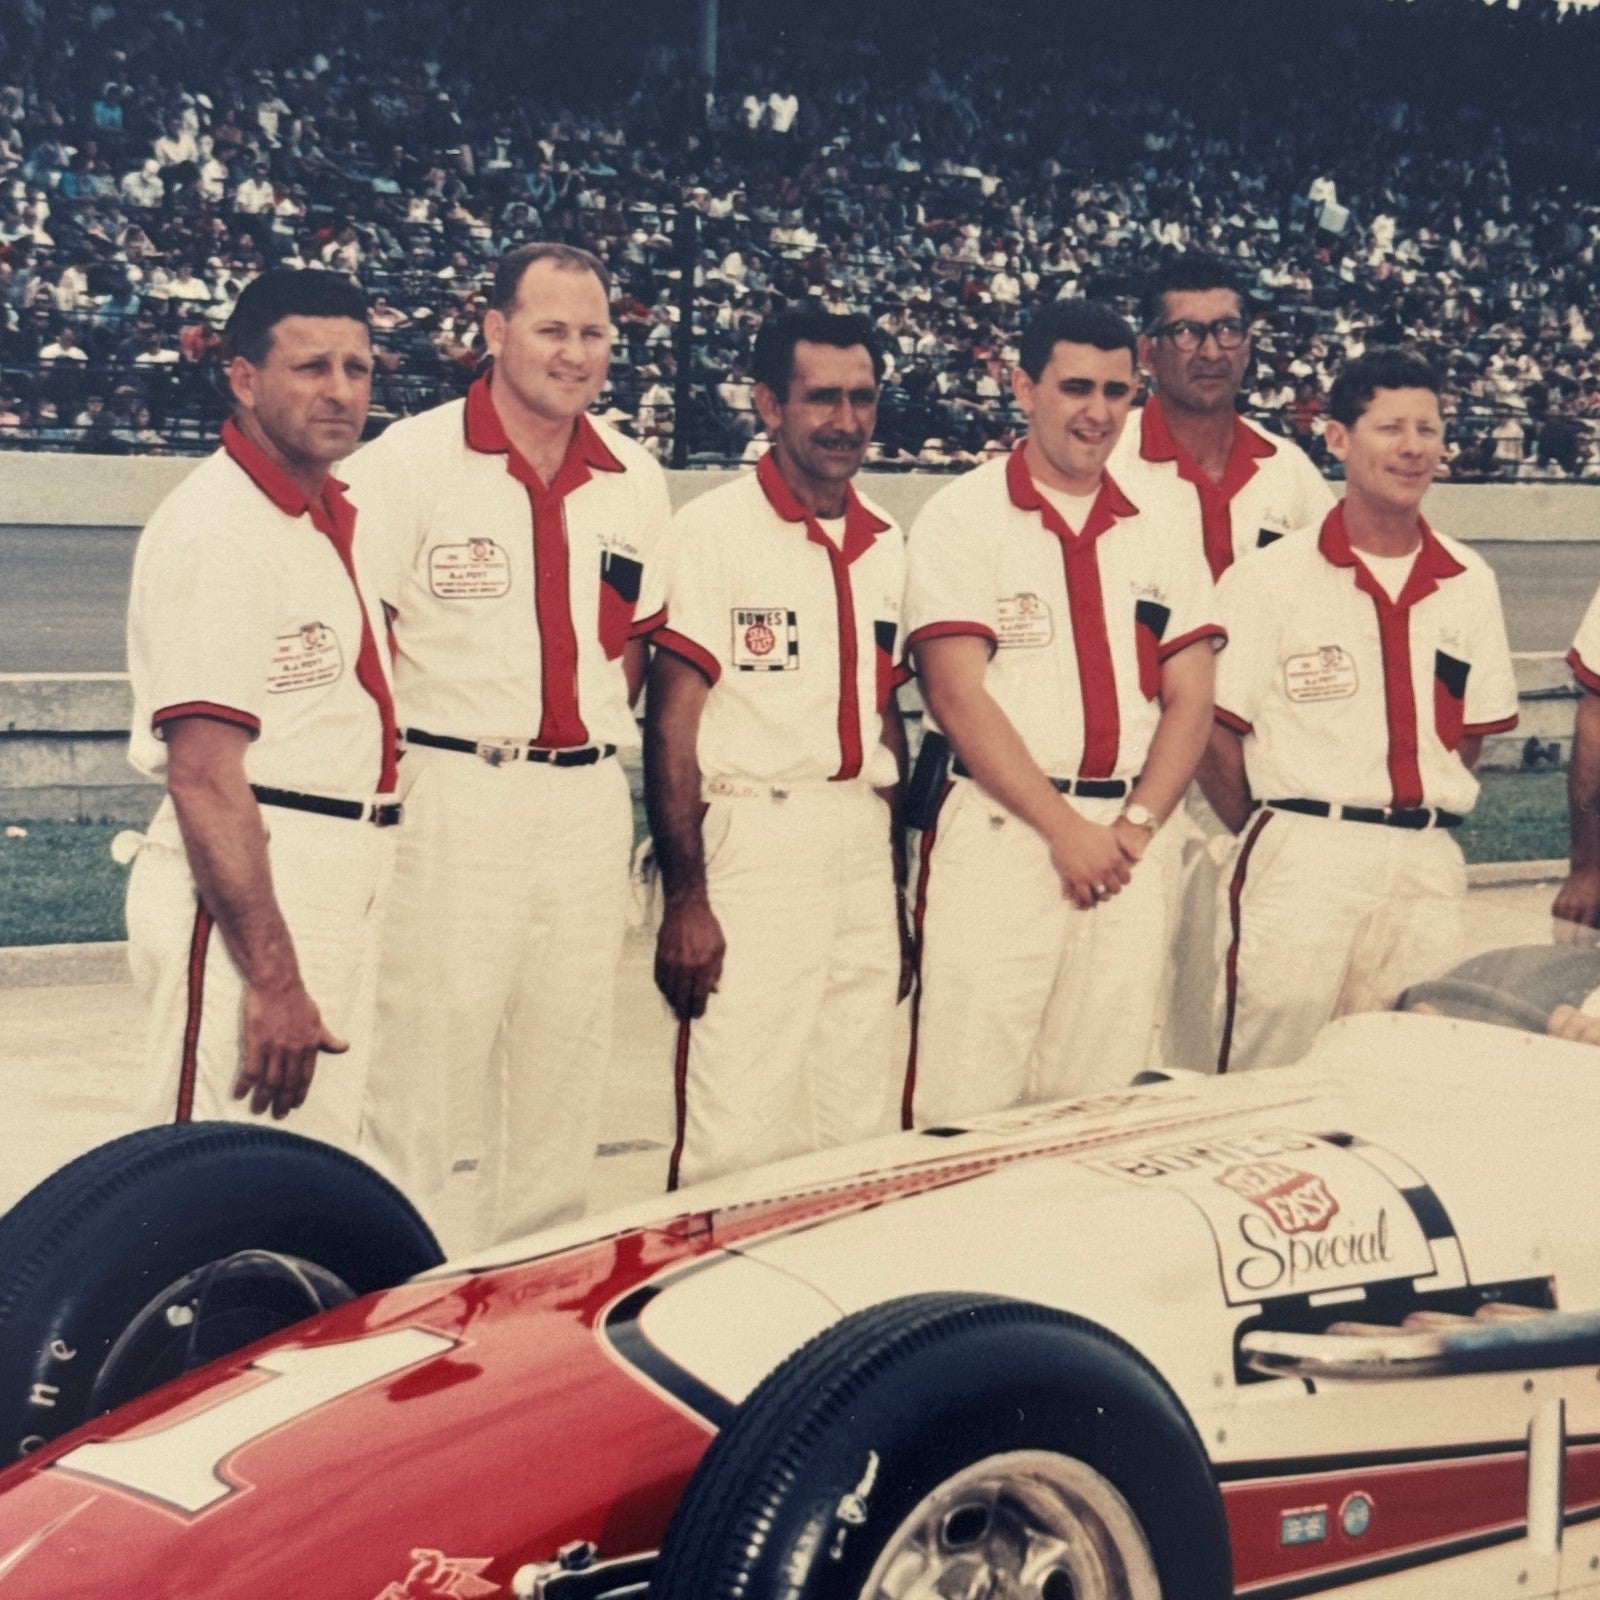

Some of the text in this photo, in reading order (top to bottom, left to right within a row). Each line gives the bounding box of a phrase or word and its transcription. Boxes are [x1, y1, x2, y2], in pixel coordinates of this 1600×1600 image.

[738, 612, 782, 625] BOWES
[1110, 1136, 1315, 1176] BOWES
[1237, 1207, 1391, 1290] Special
[55, 1326, 460, 1514] 1
